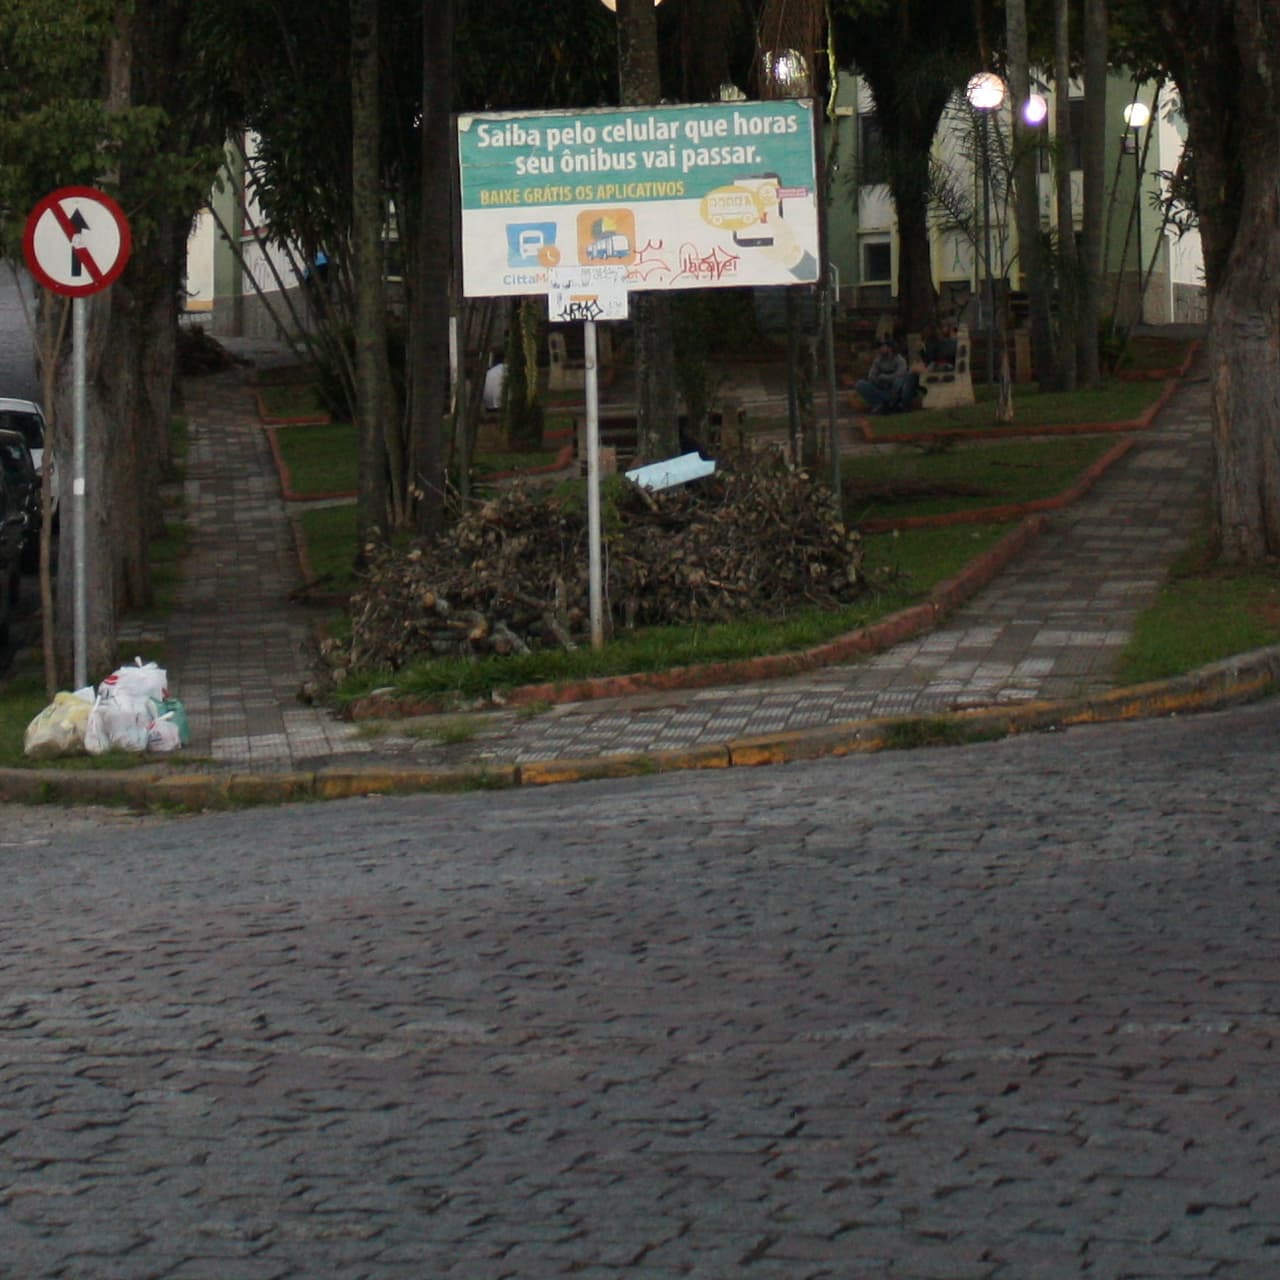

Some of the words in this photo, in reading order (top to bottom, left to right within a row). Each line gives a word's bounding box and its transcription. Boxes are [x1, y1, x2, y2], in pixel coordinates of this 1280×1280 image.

[477, 123, 541, 148] Saiba
[547, 120, 596, 151] pelo
[602, 116, 679, 143] celular
[684, 118, 728, 144] que
[733, 111, 798, 136] horas
[515, 155, 555, 175] seu
[560, 148, 637, 173] ônibus
[642, 144, 676, 169] vai
[682, 145, 762, 173] passar.
[480, 188, 520, 205] BAIXE
[524, 184, 573, 203] GRÁTIS
[575, 185, 592, 200] OS
[596, 180, 685, 200] APLICATIVOS
